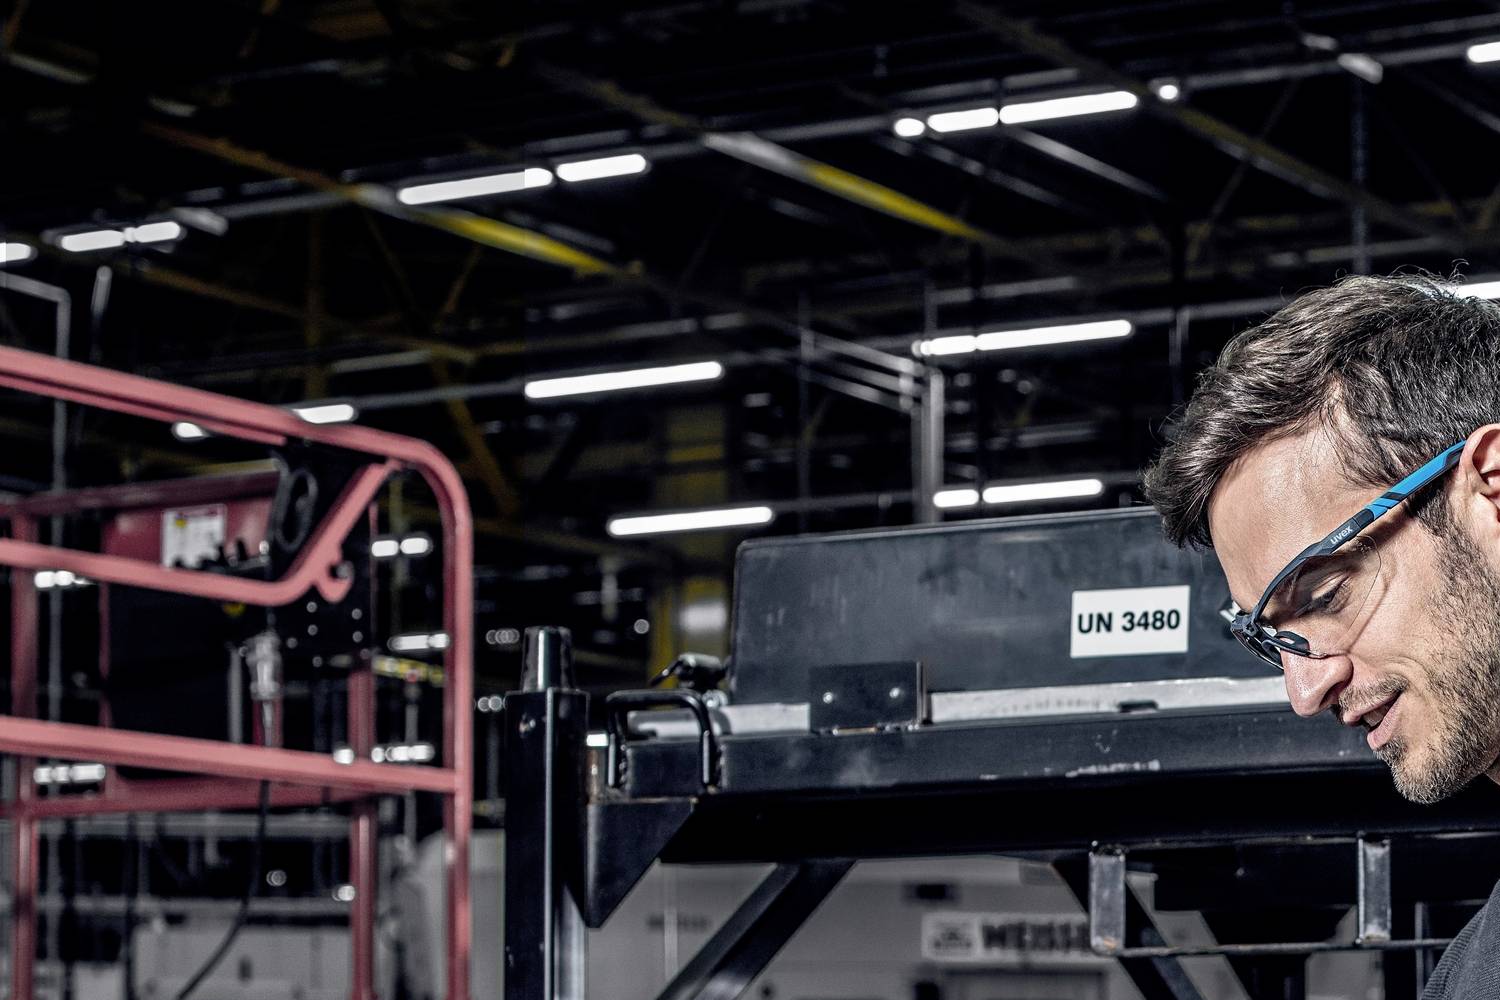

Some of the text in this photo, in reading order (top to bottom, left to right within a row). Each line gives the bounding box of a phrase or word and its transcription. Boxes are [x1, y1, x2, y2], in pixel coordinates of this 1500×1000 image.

[1330, 525, 1353, 545] uvex
[1078, 608, 1181, 634] UN 3480
